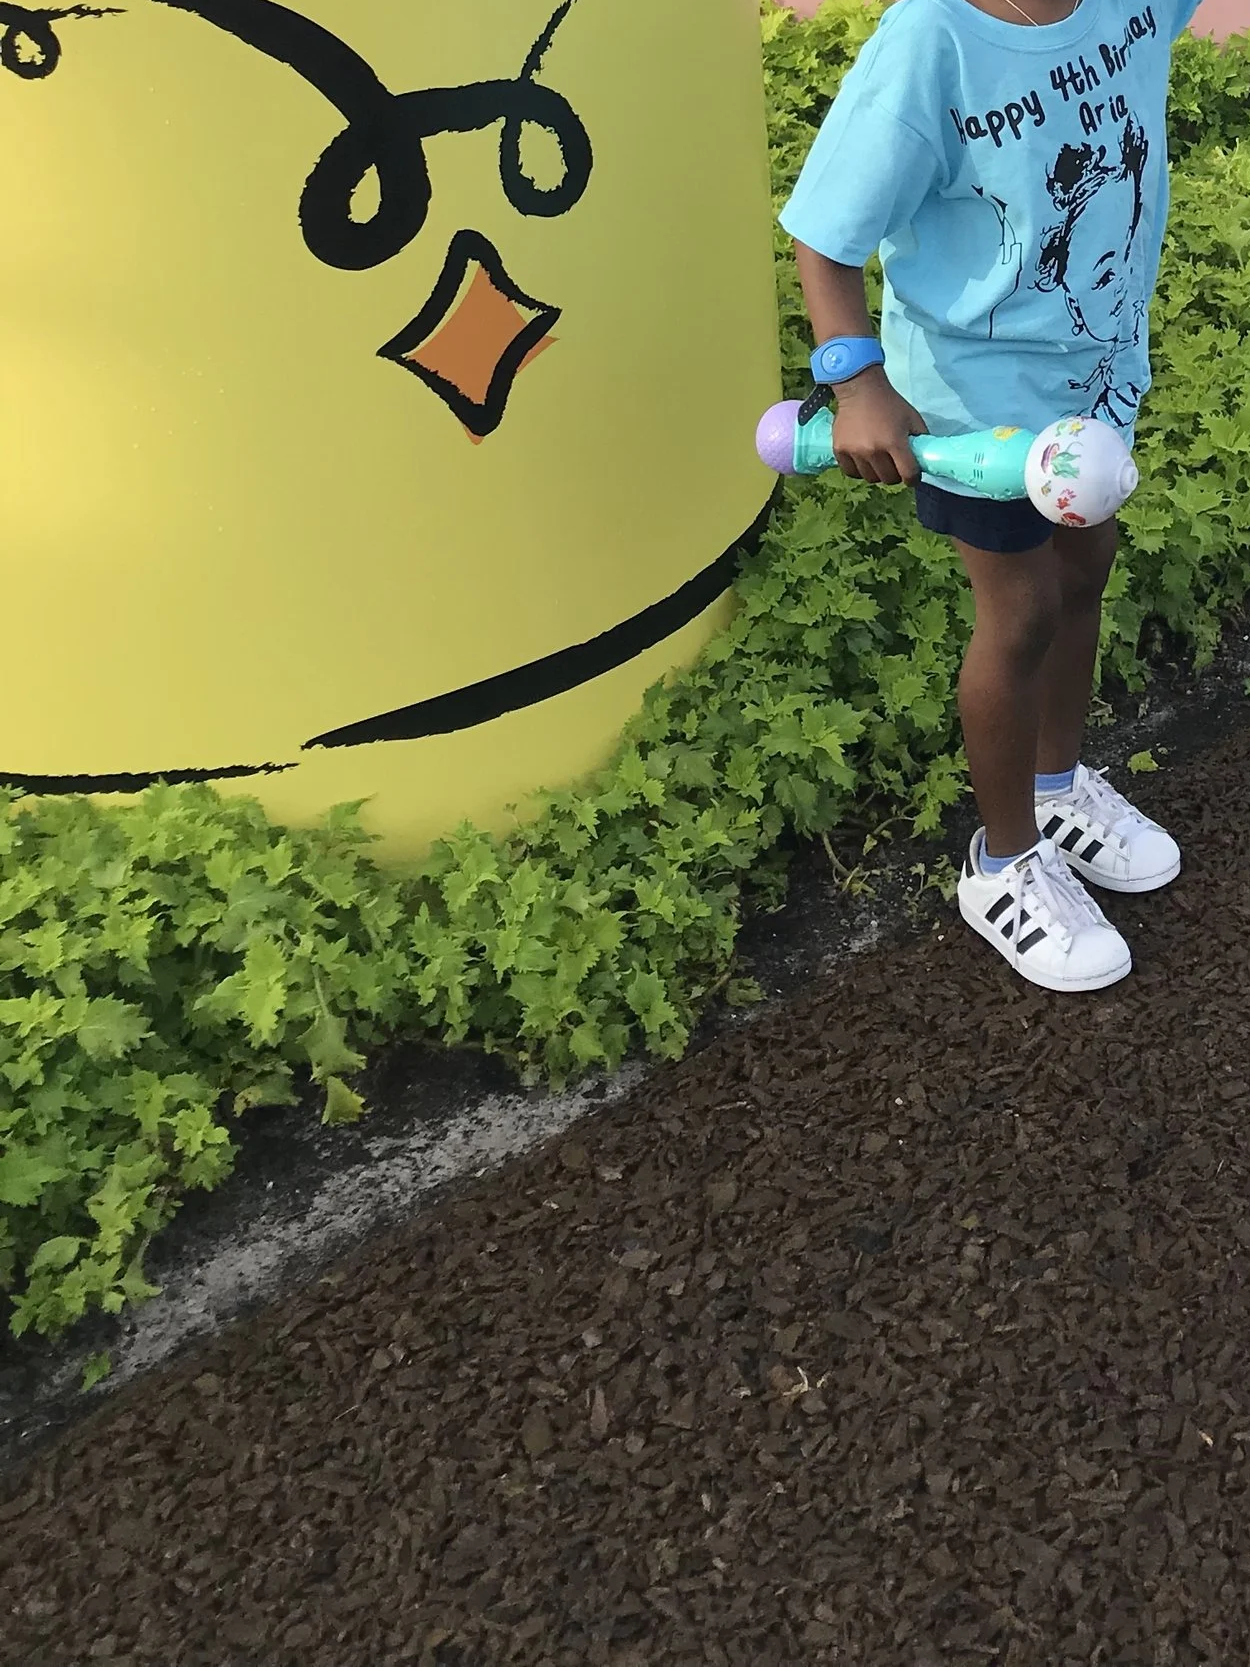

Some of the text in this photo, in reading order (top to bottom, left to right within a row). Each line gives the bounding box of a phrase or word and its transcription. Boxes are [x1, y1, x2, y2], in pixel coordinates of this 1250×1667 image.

[1049, 55, 1101, 102] 4th
[1098, 5, 1157, 79] Biray
[1079, 94, 1129, 136] Aria
